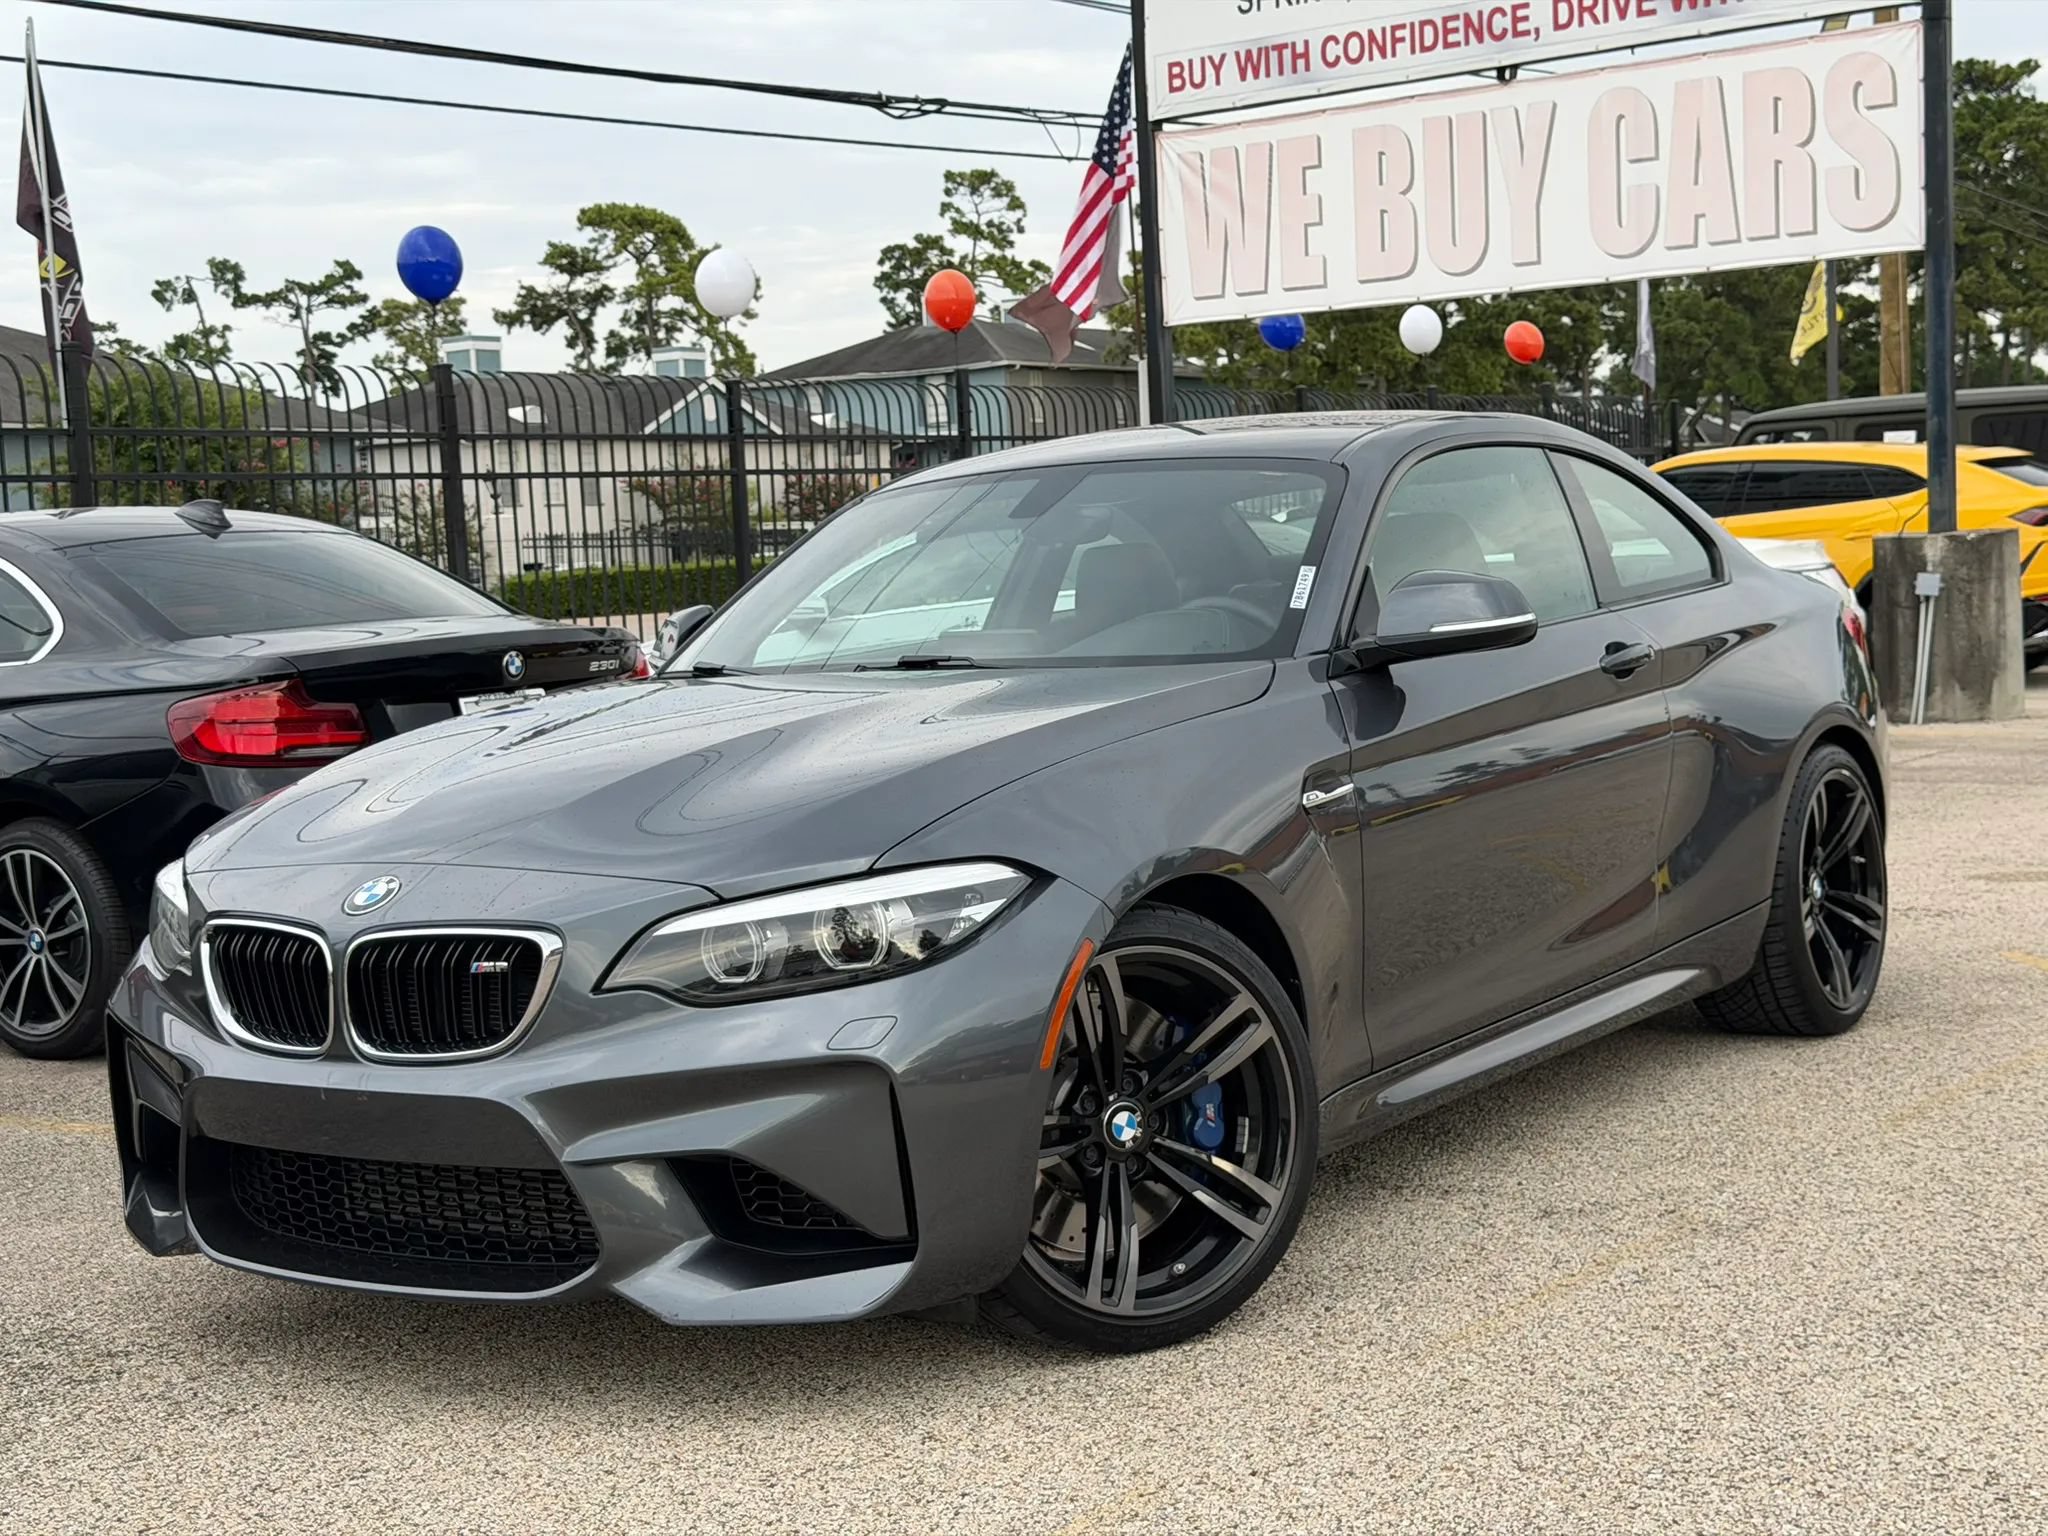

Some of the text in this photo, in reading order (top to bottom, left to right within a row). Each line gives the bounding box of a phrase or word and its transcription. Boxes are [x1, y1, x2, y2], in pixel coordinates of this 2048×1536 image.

[1167, 52, 1227, 93] BUY
[1234, 39, 1311, 82] WITH
[1320, 2, 1540, 69] CONFIDENCE,
[1178, 51, 1901, 300] WE BUY CARS
